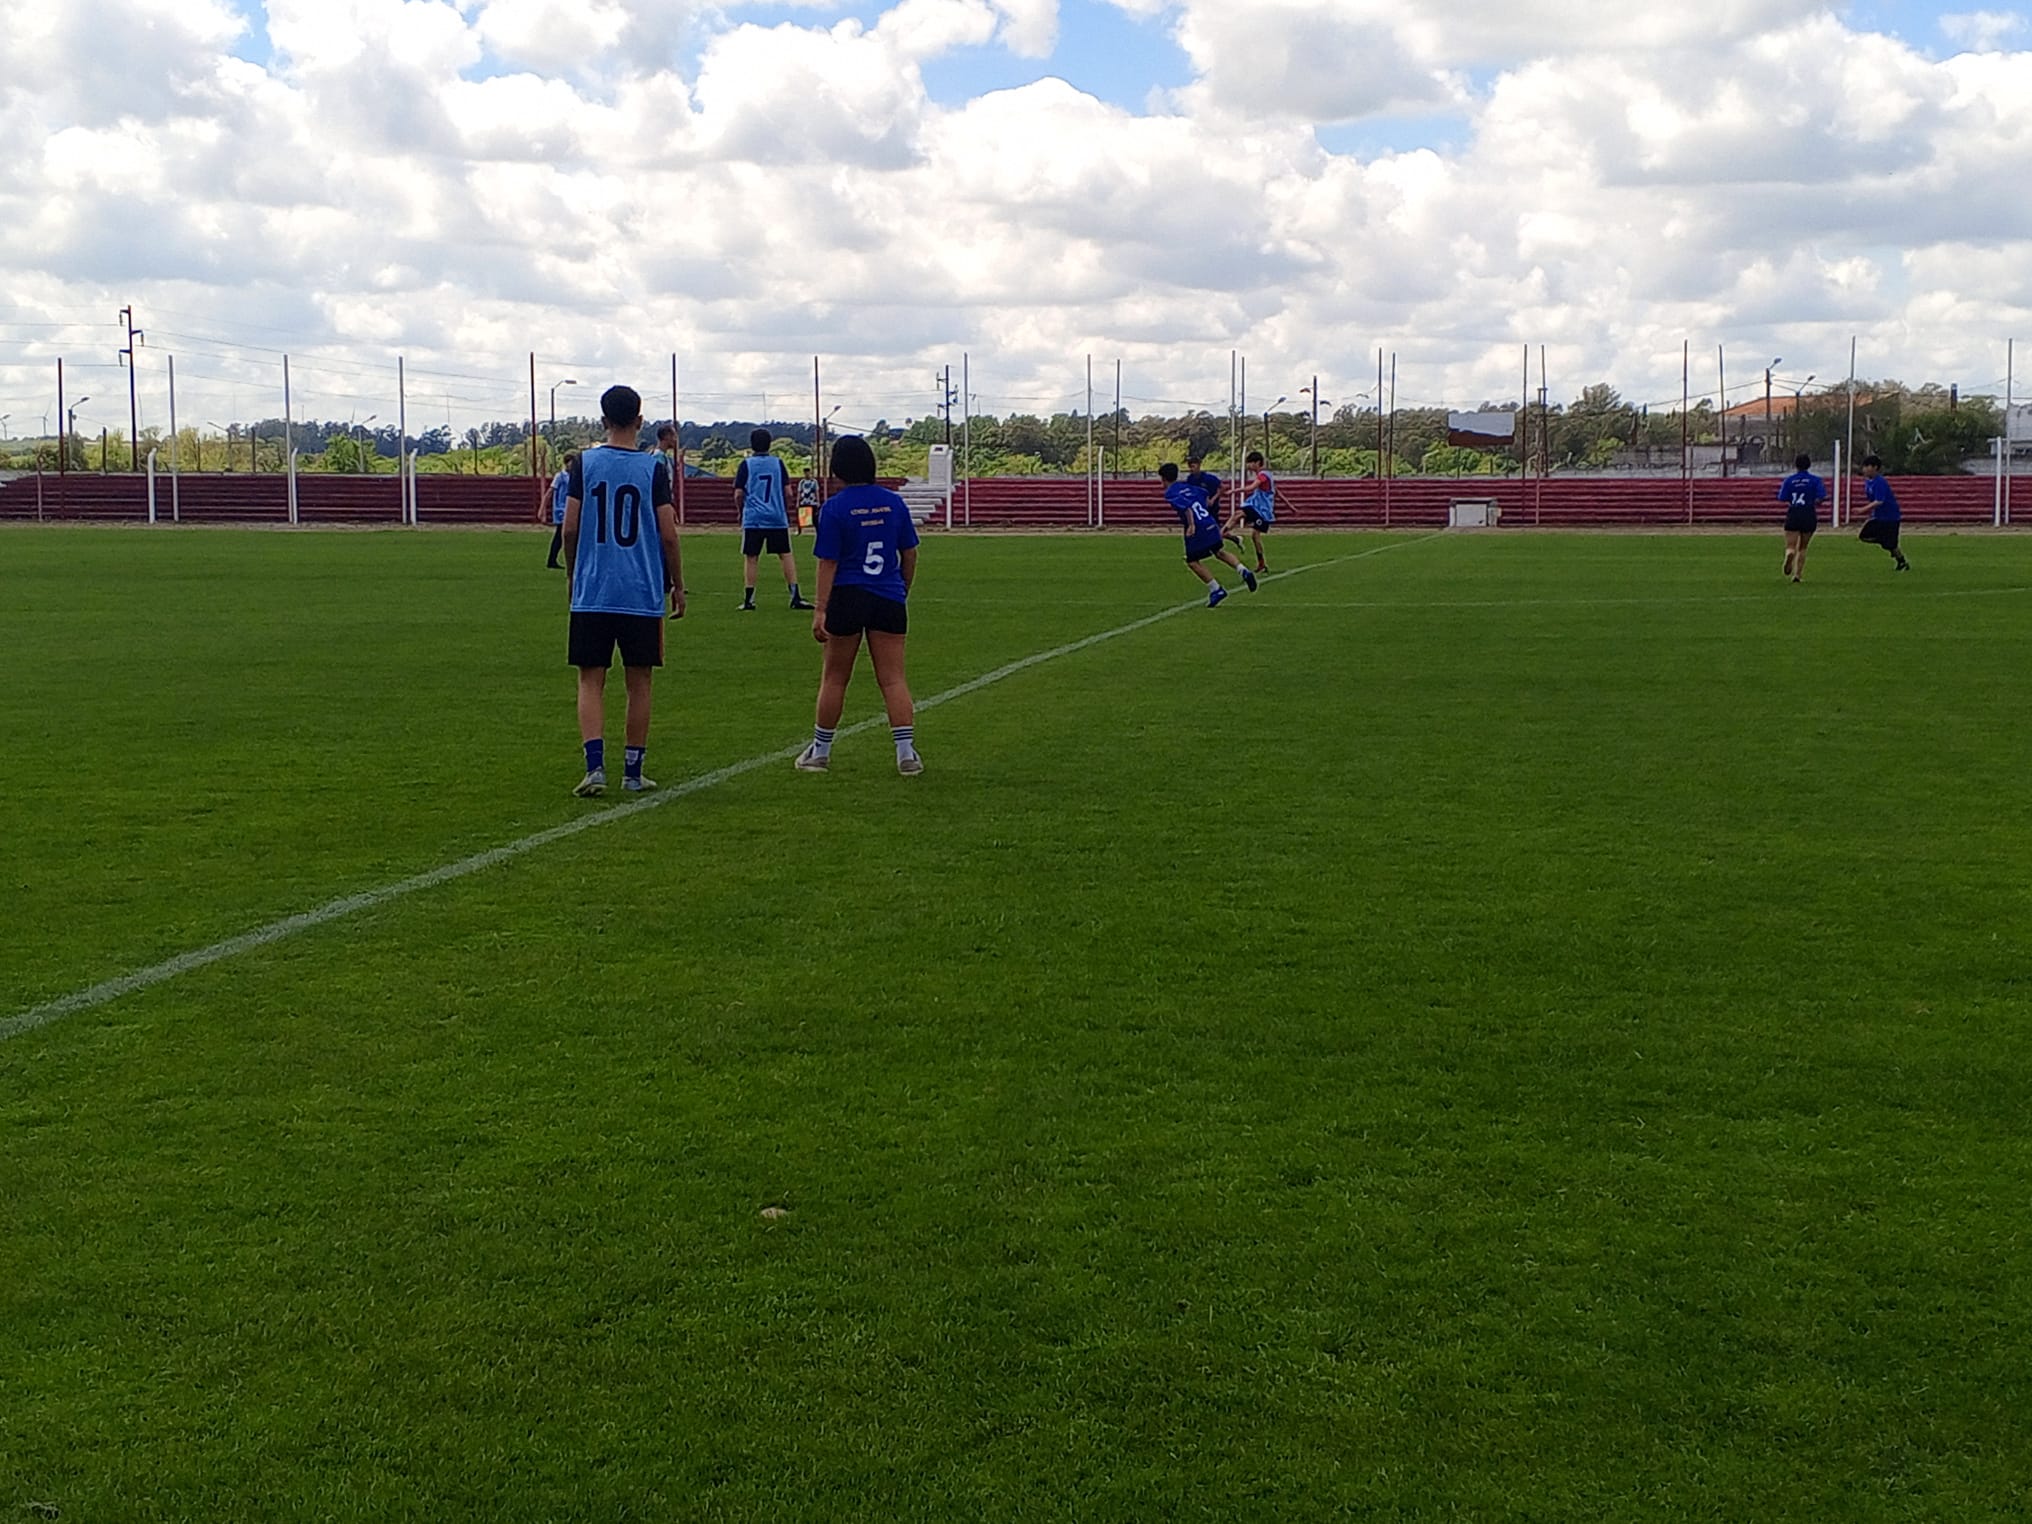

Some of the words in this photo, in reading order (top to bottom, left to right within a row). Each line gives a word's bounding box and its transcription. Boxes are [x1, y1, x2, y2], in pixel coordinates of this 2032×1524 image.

[758, 474, 772, 503] 7
[591, 481, 640, 548] 10
[862, 541, 885, 575] 5
